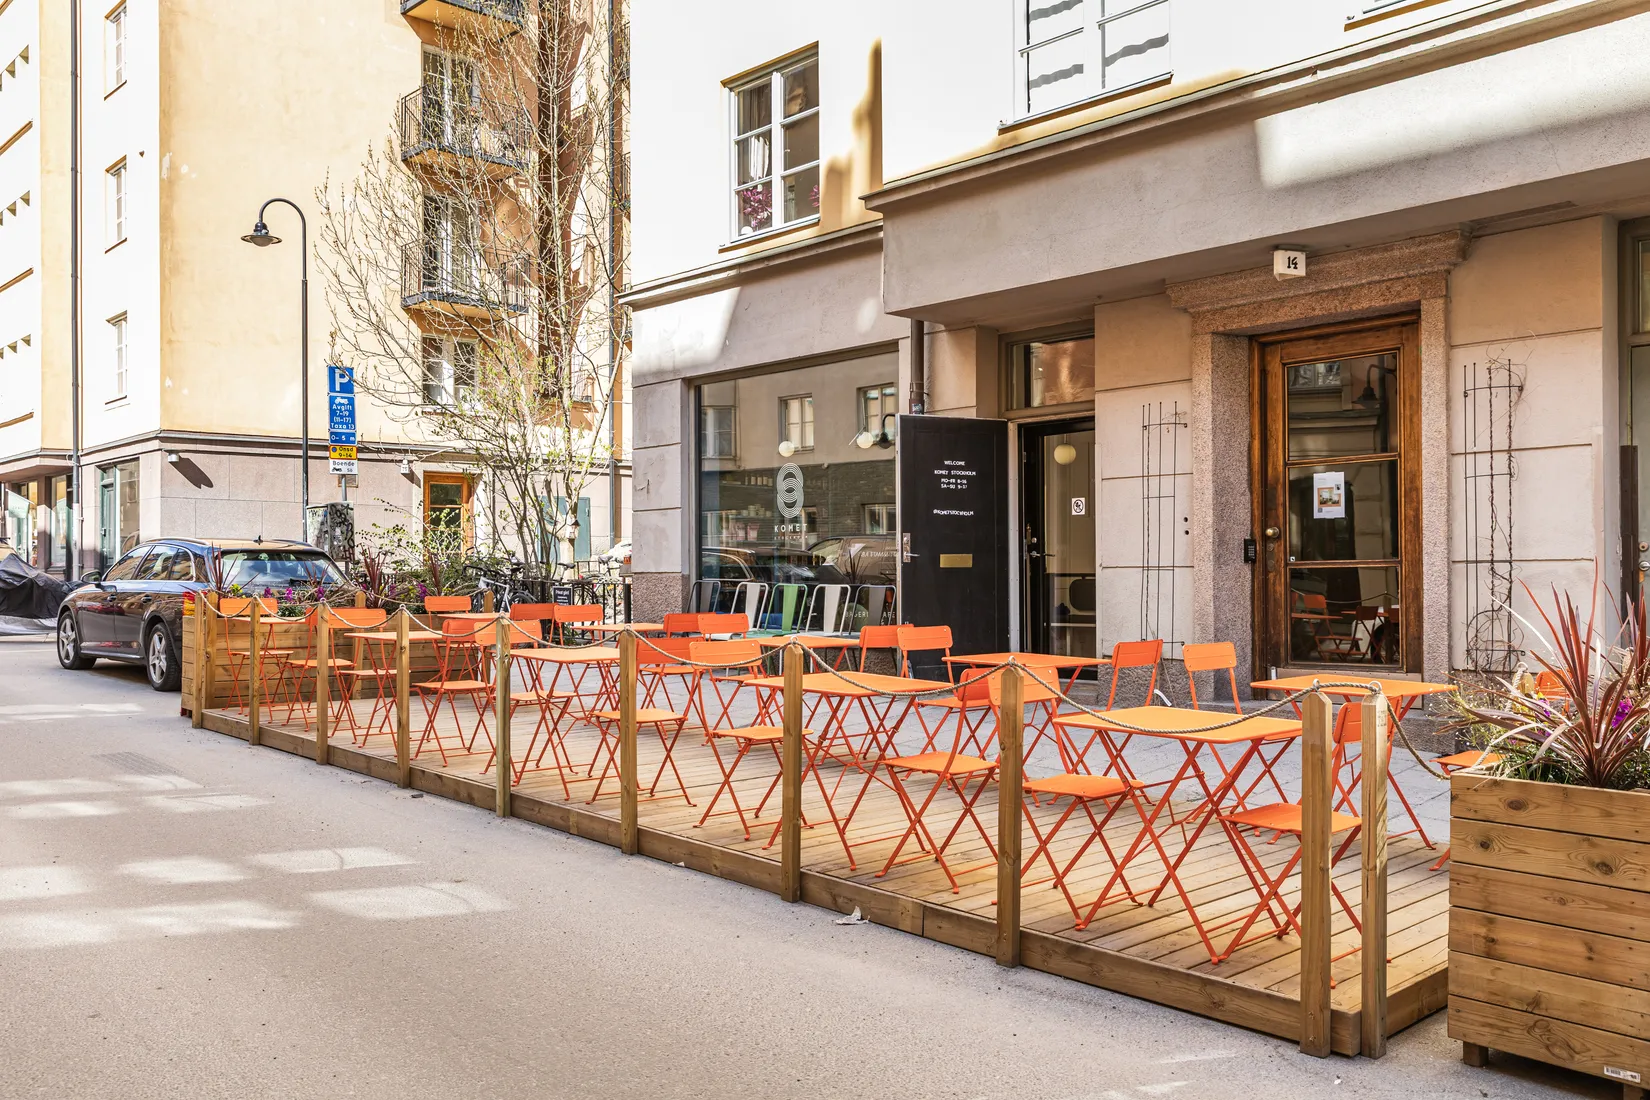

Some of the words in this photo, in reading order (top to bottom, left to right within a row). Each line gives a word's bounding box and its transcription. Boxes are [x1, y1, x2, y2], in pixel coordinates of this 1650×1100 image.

[1287, 256, 1298, 269] 14
[335, 368, 350, 391] P
[774, 524, 808, 533] KOMET
